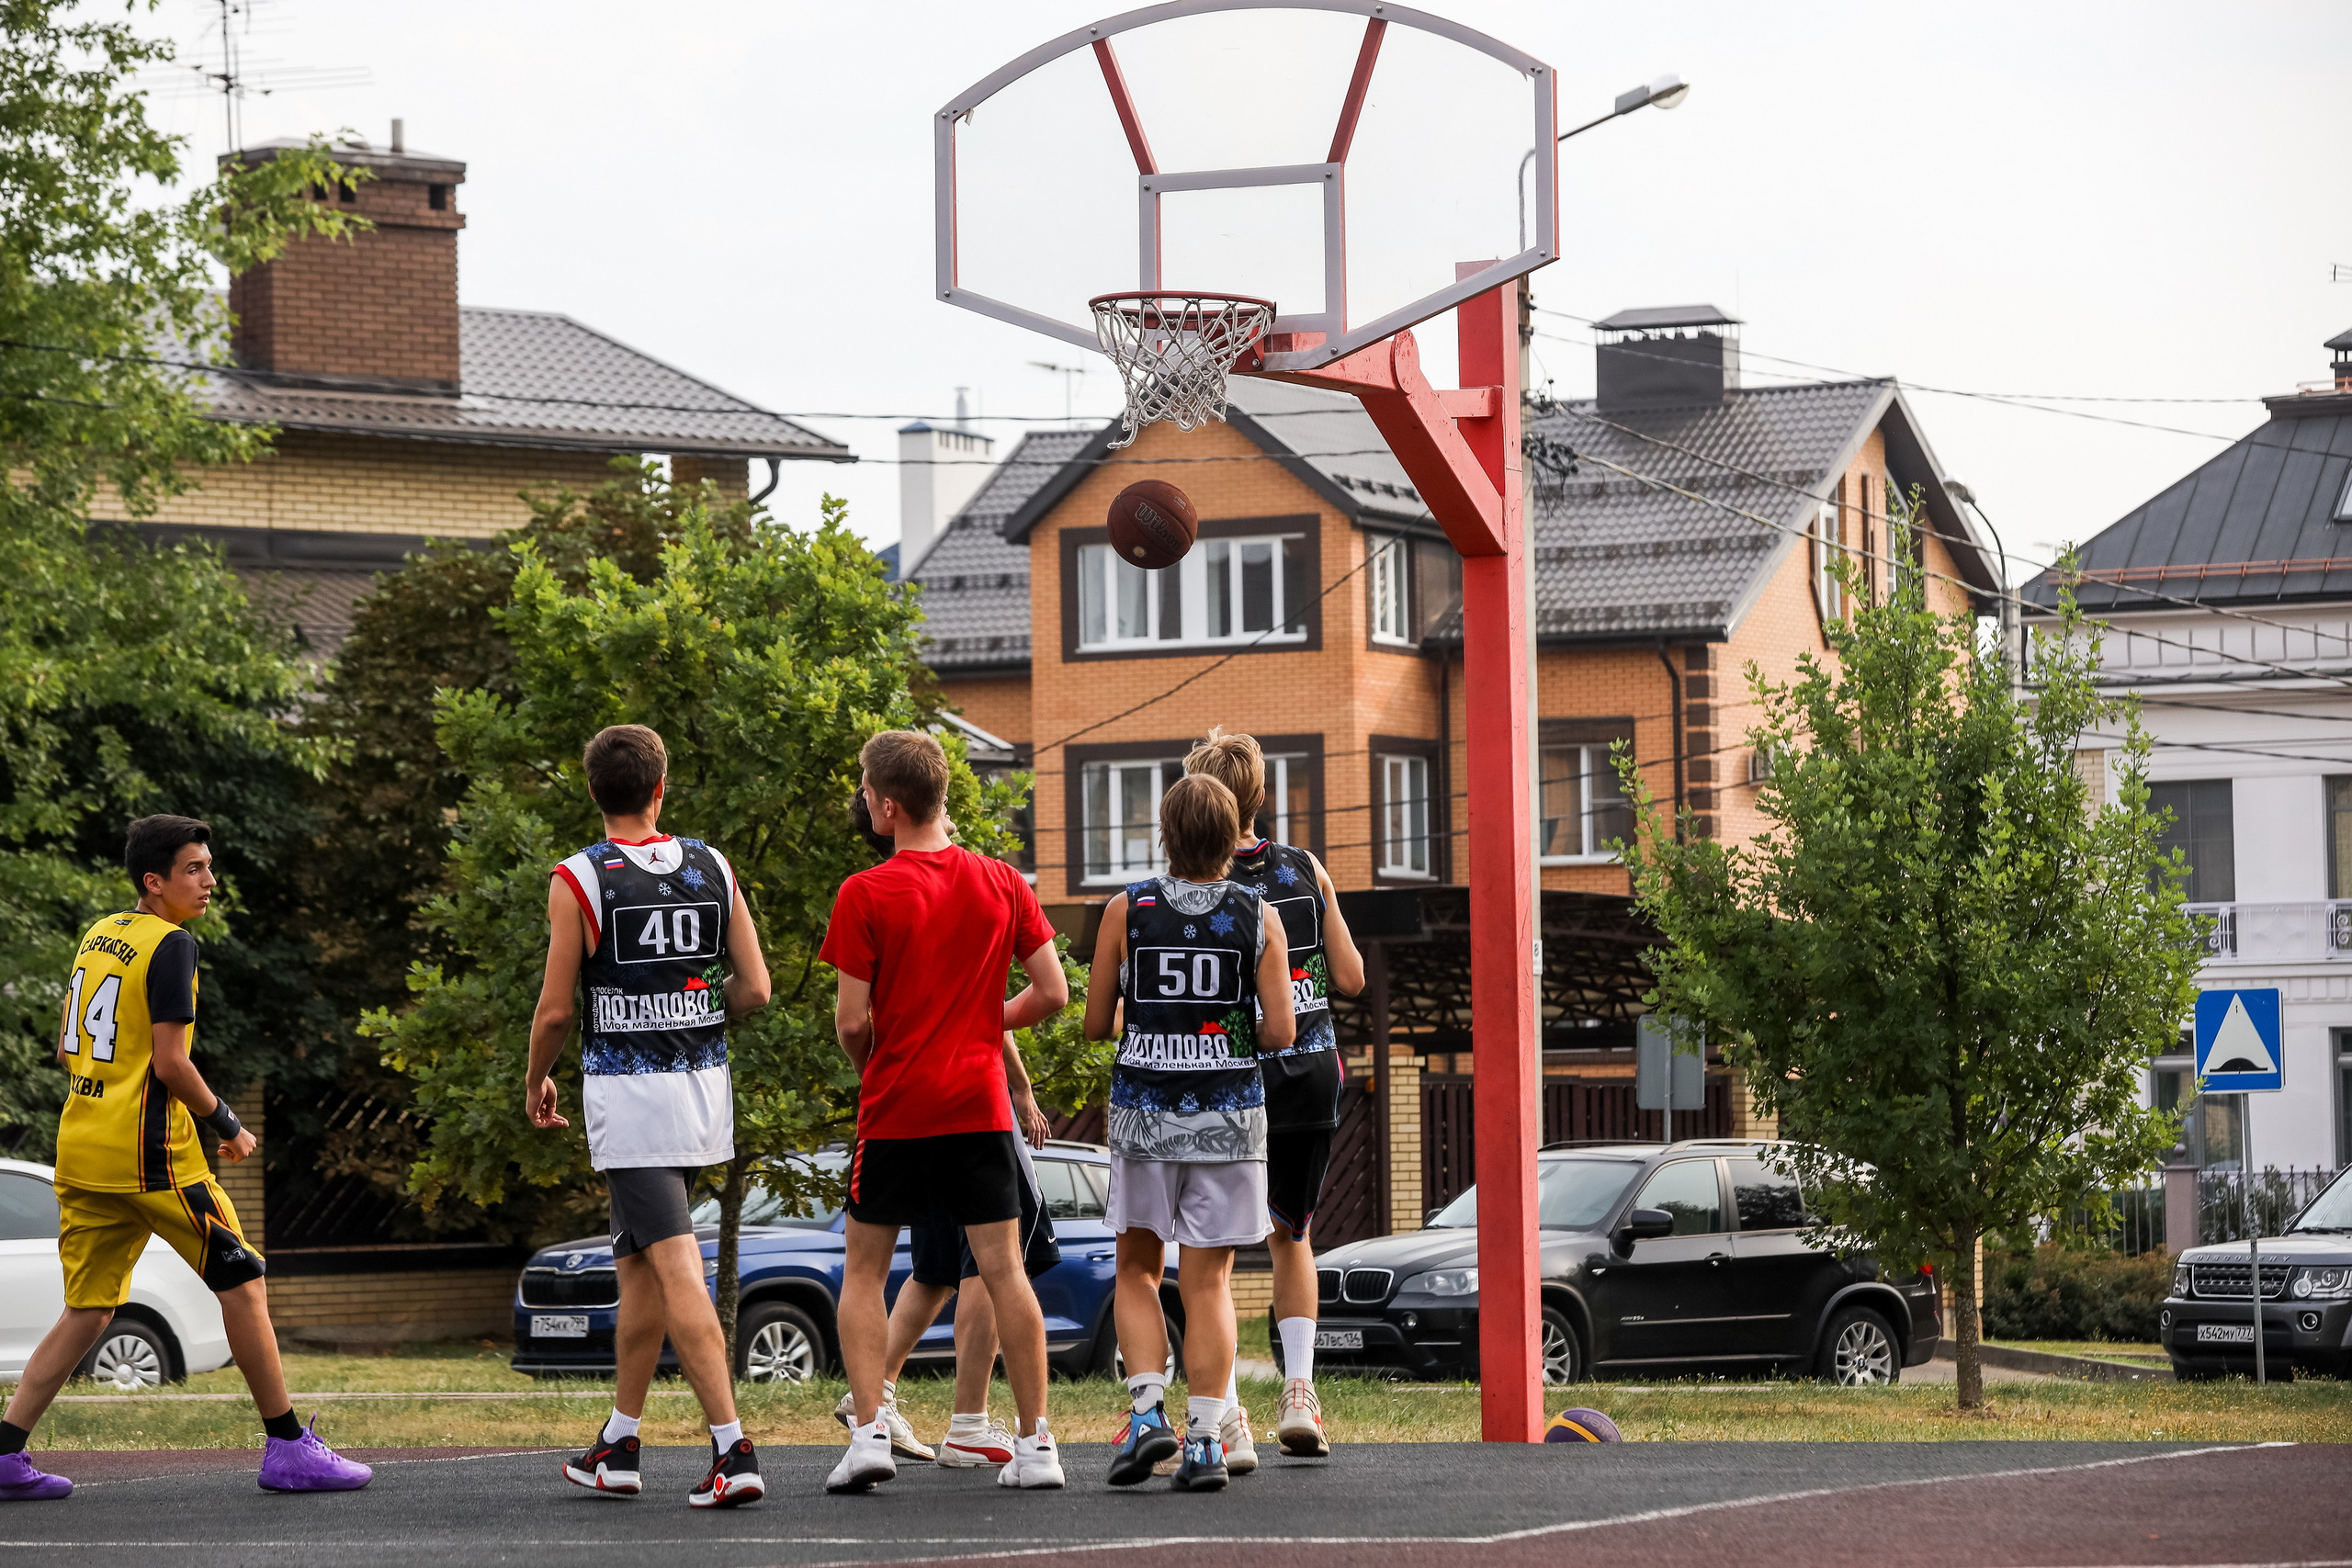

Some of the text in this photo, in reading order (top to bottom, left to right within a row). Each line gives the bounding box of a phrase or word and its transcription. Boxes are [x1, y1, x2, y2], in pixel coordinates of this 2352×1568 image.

[1135, 502, 1182, 551] Wilson
[638, 908, 700, 955] 40
[80, 935, 139, 967] САРКИСЯН
[1158, 952, 1220, 998] 50
[64, 966, 122, 1064] 14
[600, 989, 709, 1021] ПОТАПОВО
[603, 1021, 628, 1032] Моя
[632, 1018, 696, 1030] маленькая
[1144, 1058, 1212, 1069] маленькая
[1216, 1058, 1257, 1068] Москва
[2236, 1326, 2252, 1337] 777
